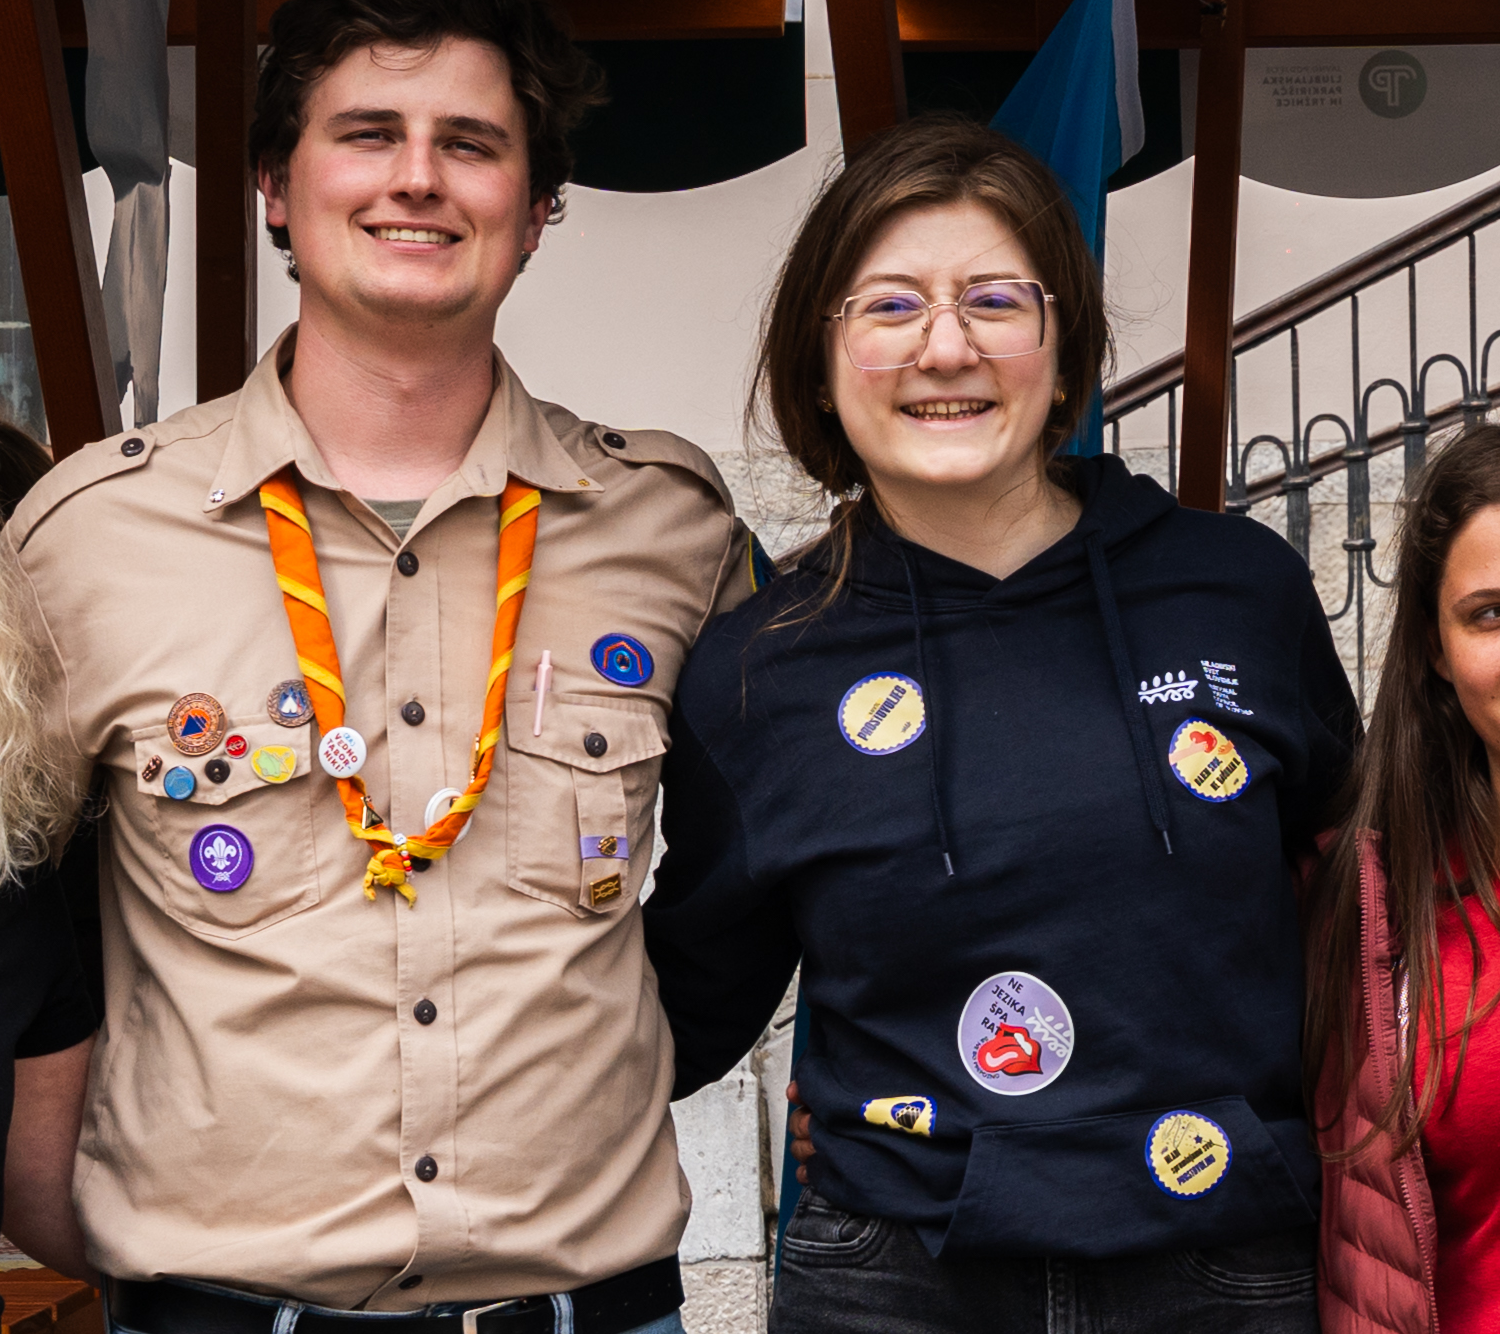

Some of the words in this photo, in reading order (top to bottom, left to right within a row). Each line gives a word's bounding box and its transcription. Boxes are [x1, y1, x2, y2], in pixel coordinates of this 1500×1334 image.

[334, 733, 358, 763] VEDNO
[323, 750, 344, 772] NIKI!
[1008, 977, 1023, 994] NE
[989, 1000, 1008, 1022] ŠPA
[991, 984, 1025, 1016] JEZIKA
